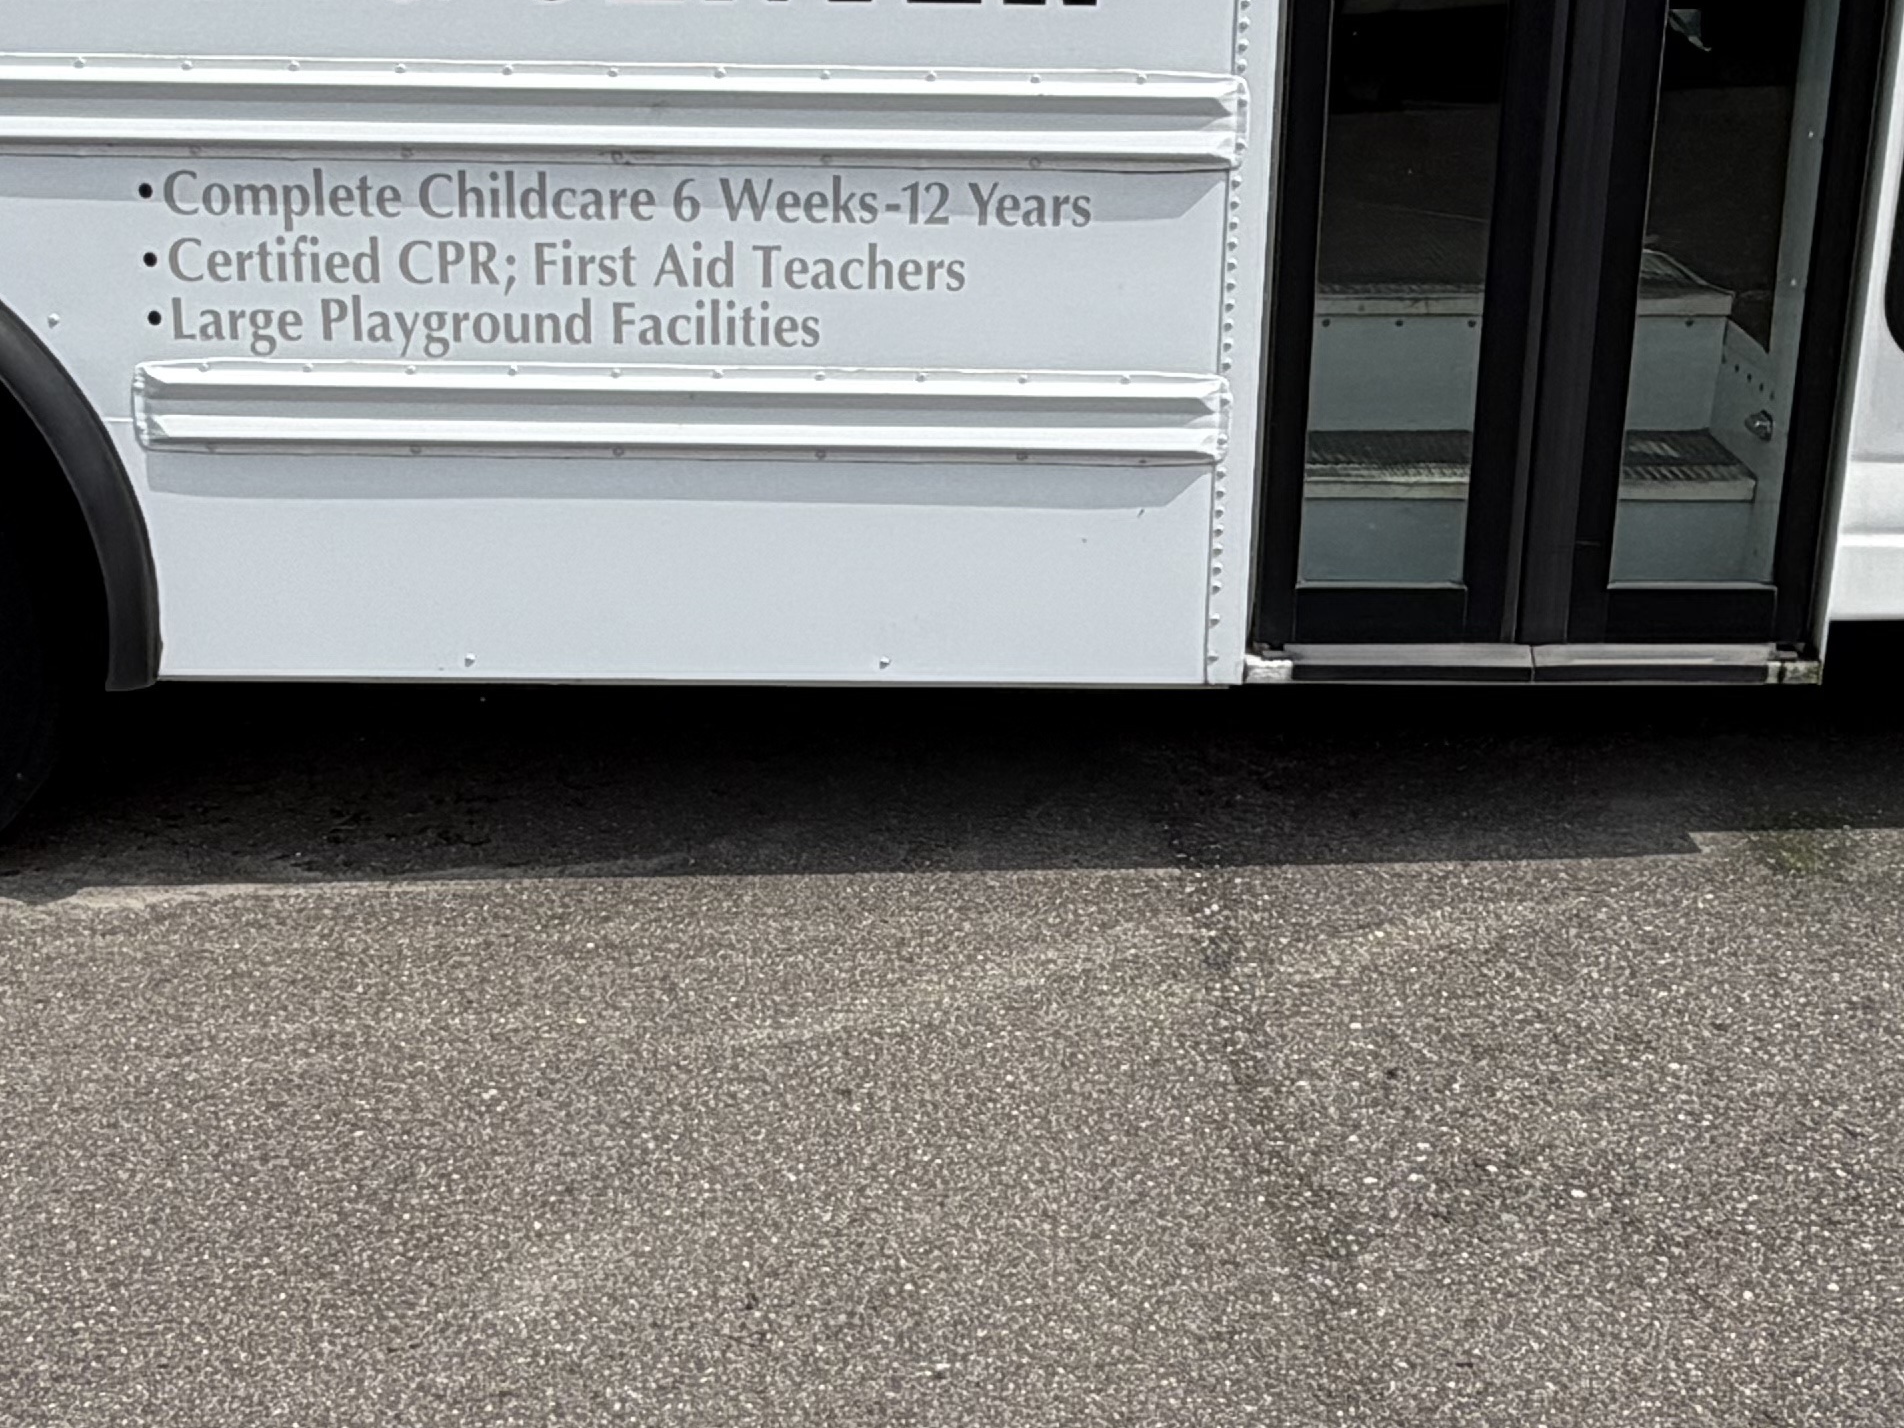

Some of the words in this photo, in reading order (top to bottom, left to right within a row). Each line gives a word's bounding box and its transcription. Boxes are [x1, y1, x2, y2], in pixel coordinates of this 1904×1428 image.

[162, 167, 403, 232] Complete
[418, 169, 657, 223] Childcare
[673, 177, 702, 223] 6
[968, 180, 1093, 228] Years
[168, 234, 381, 286] Certified
[398, 239, 517, 297] CPR;
[533, 238, 637, 288] First
[653, 239, 735, 288] Aid
[752, 242, 967, 292] Teachers
[171, 296, 304, 358] Large
[319, 294, 593, 359] Playground
[611, 298, 822, 348] Facilities
